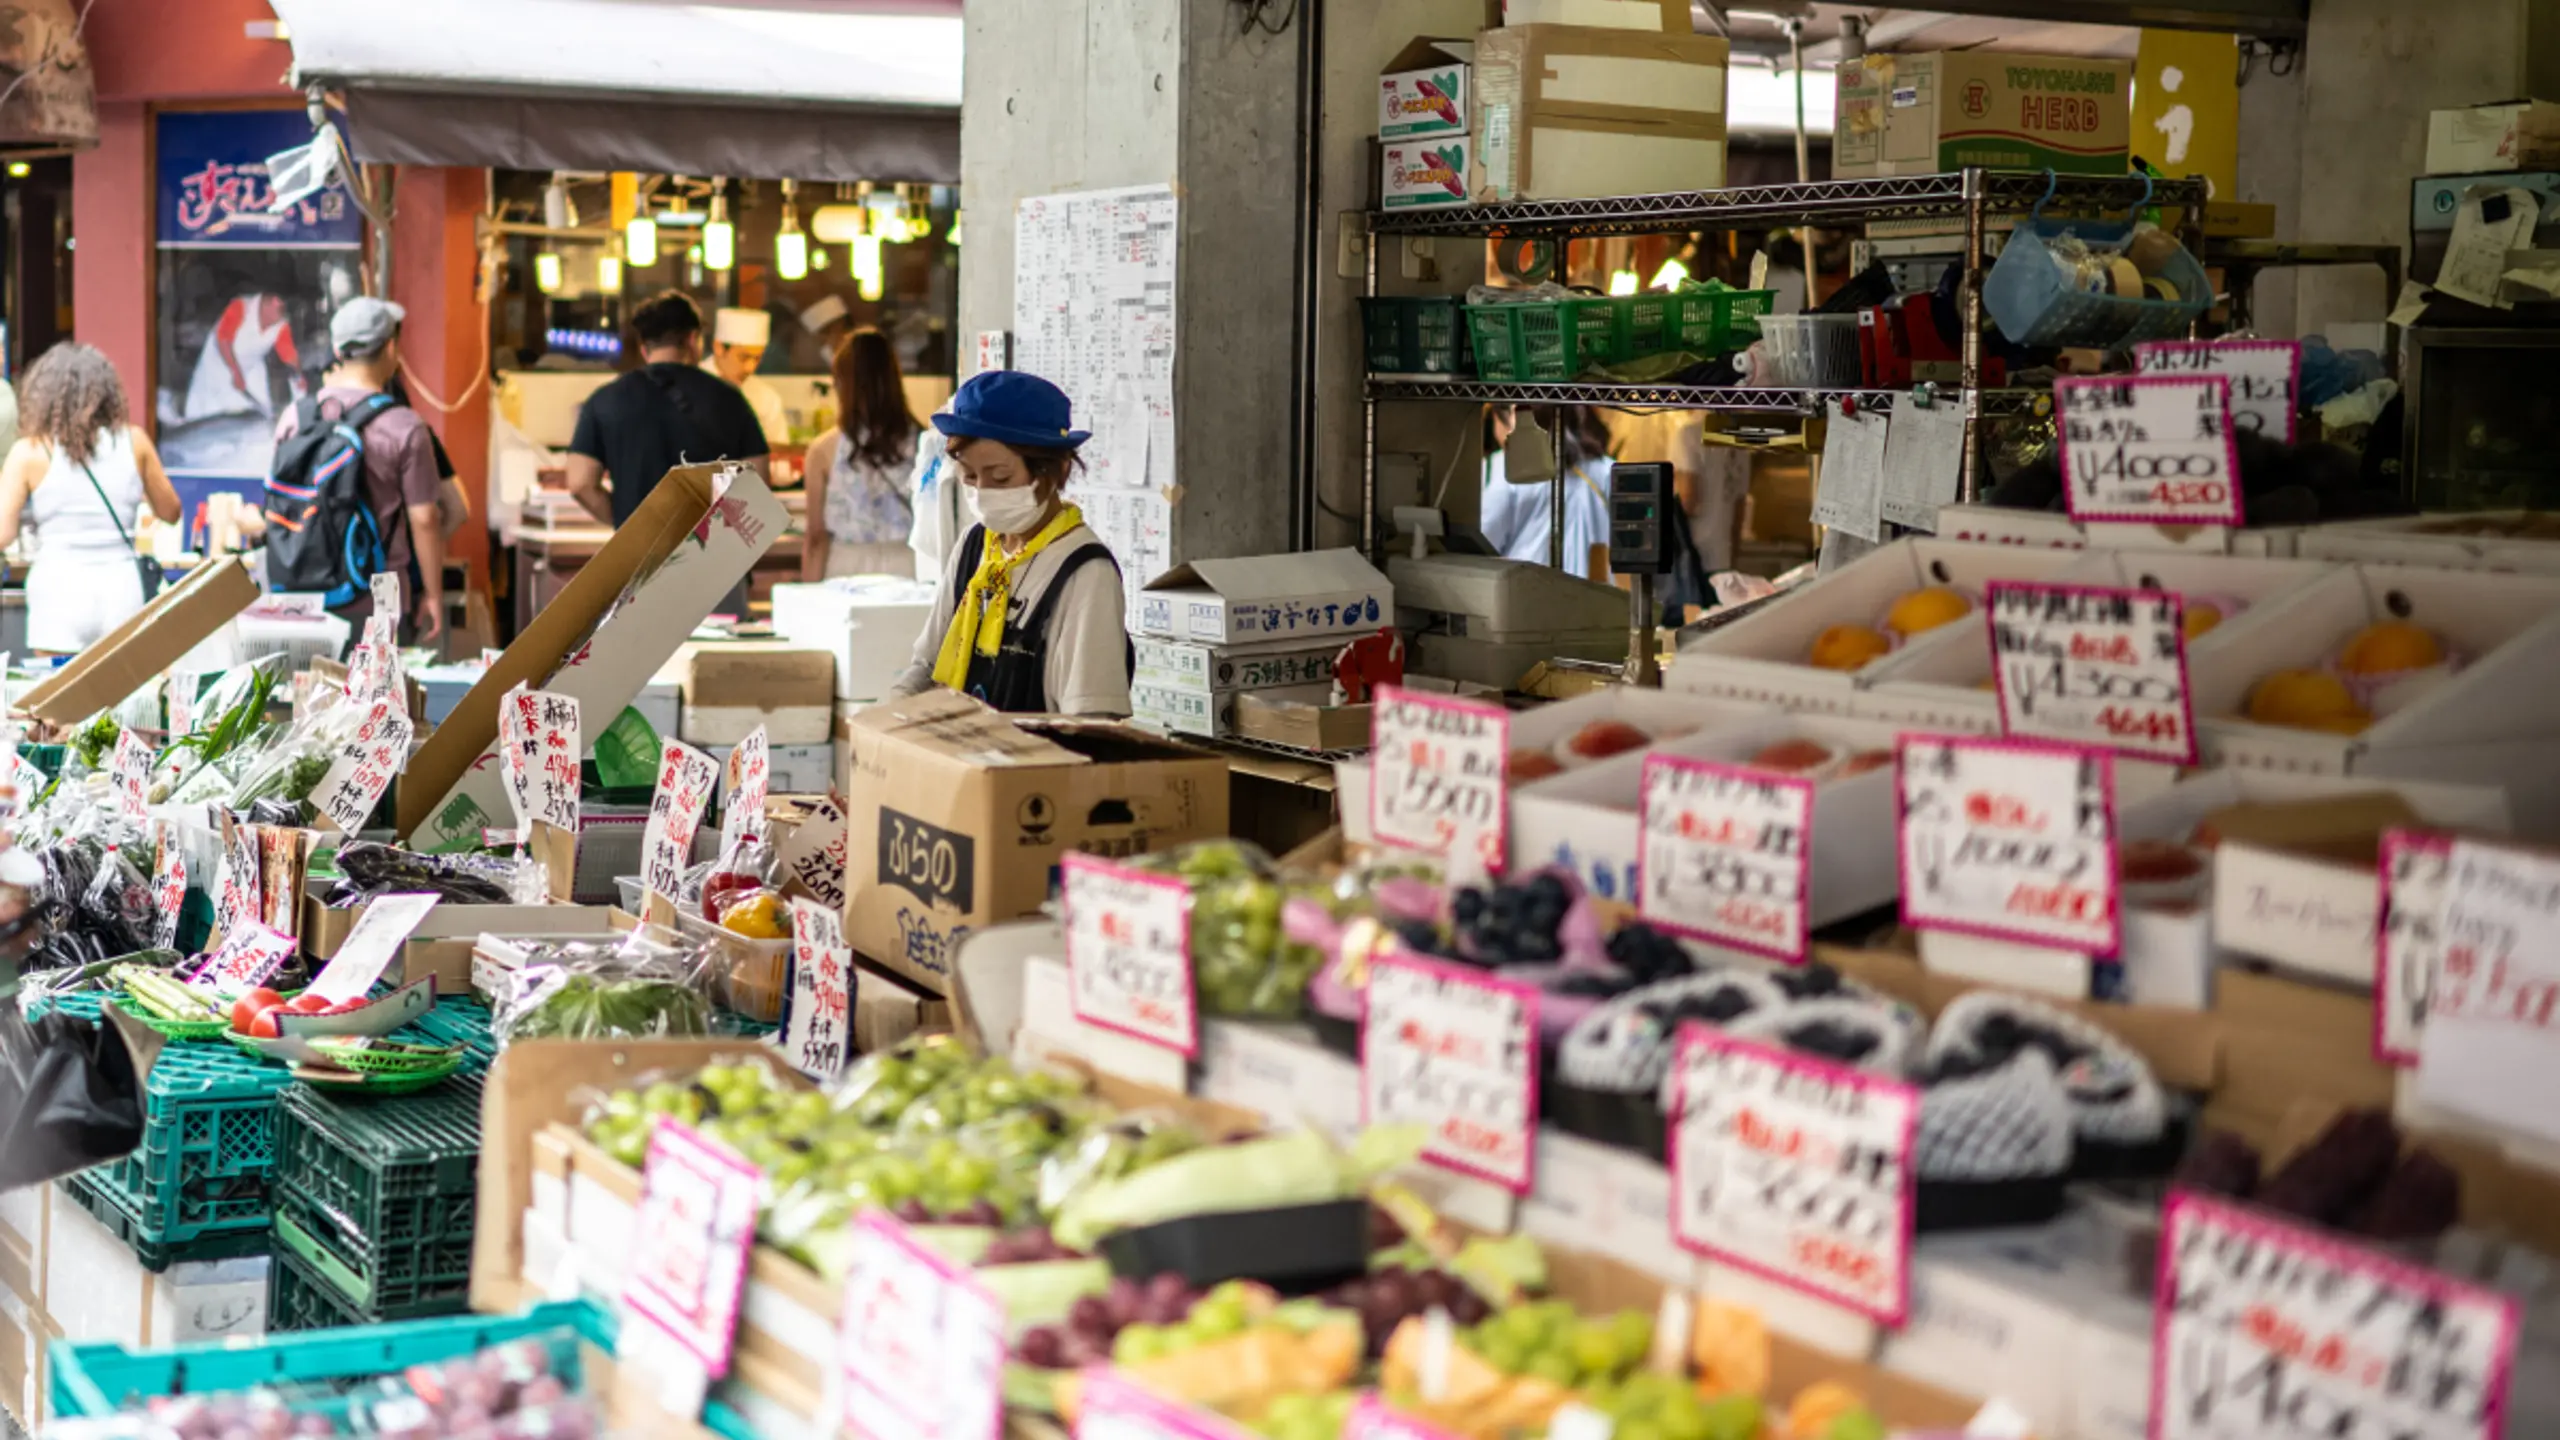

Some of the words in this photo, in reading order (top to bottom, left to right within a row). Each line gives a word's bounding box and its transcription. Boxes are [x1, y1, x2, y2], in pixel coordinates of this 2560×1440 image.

[2005, 66, 2117, 95] TOYOHASHI
[2021, 95, 2099, 132] HERB
[2077, 444, 2217, 497] ¥4000
[889, 817, 957, 895] ふらの
